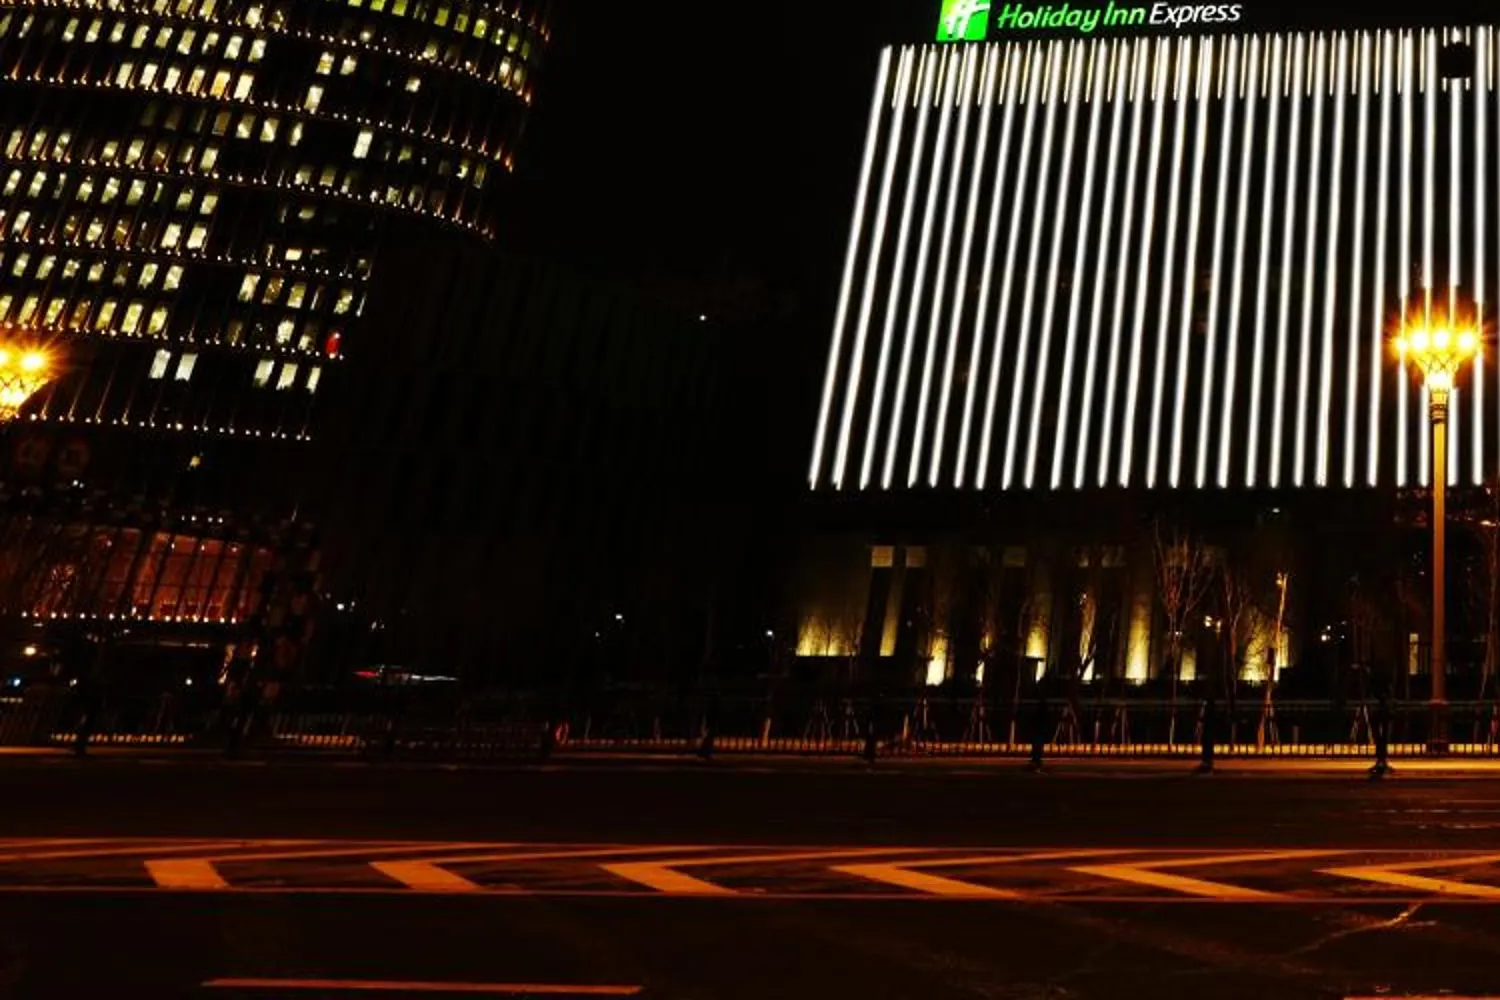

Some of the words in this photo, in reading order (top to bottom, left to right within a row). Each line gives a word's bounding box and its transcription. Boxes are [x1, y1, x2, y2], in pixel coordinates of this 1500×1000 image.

[998, 3, 1100, 32] Holiday
[1103, 0, 1146, 26] Inn
[1148, 1, 1242, 29] Express
